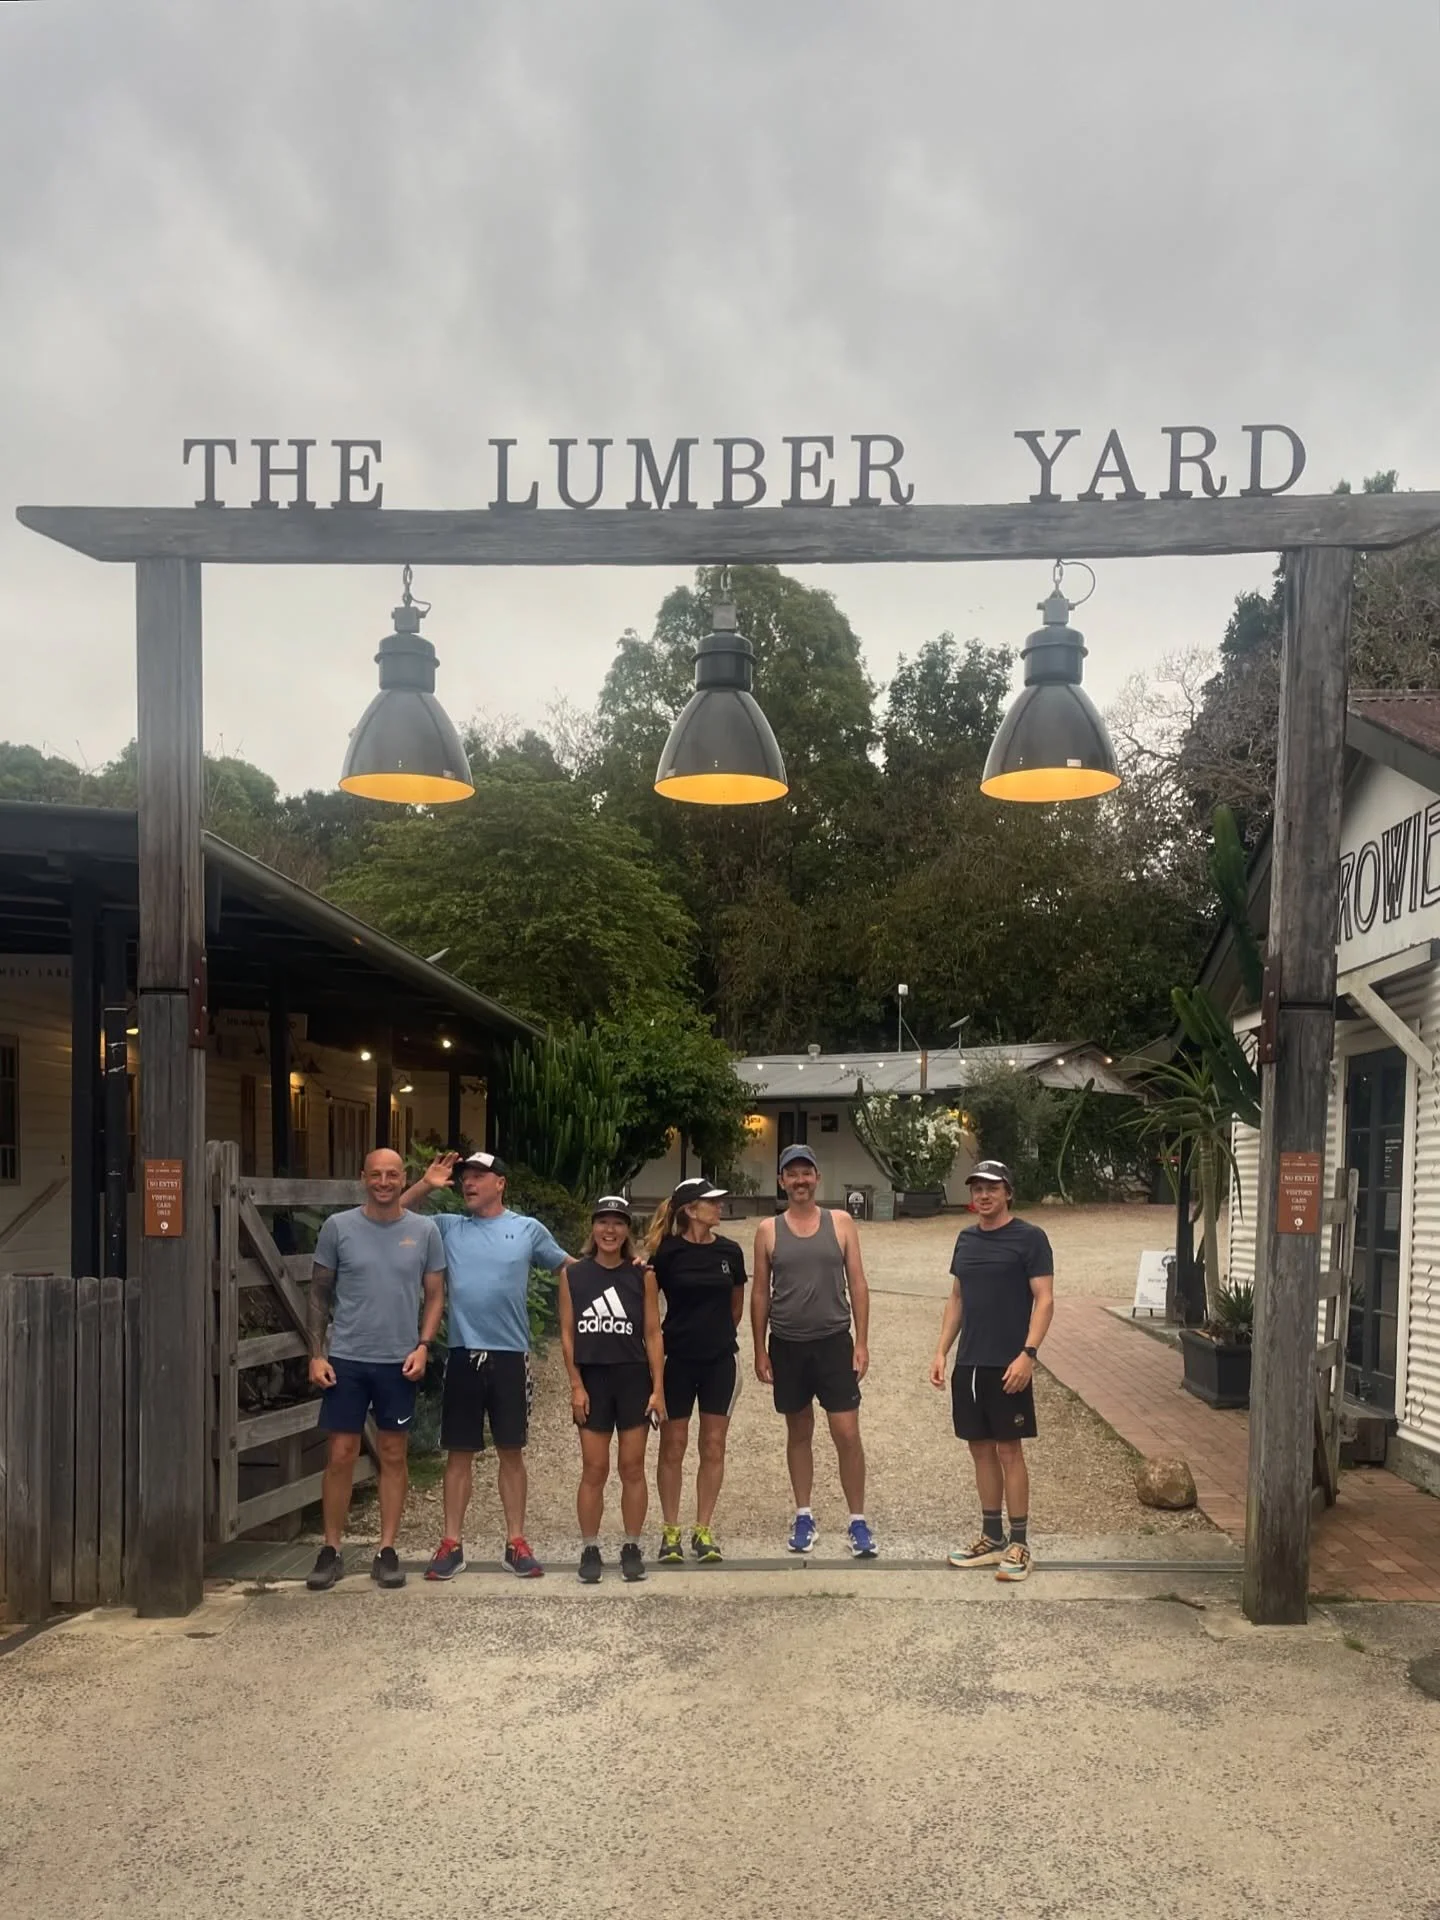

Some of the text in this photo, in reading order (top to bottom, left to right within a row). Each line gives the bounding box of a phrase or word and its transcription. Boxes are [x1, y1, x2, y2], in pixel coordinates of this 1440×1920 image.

[183, 424, 1307, 509] THE LUMBER YARD
[578, 1316, 633, 1335] adidas
